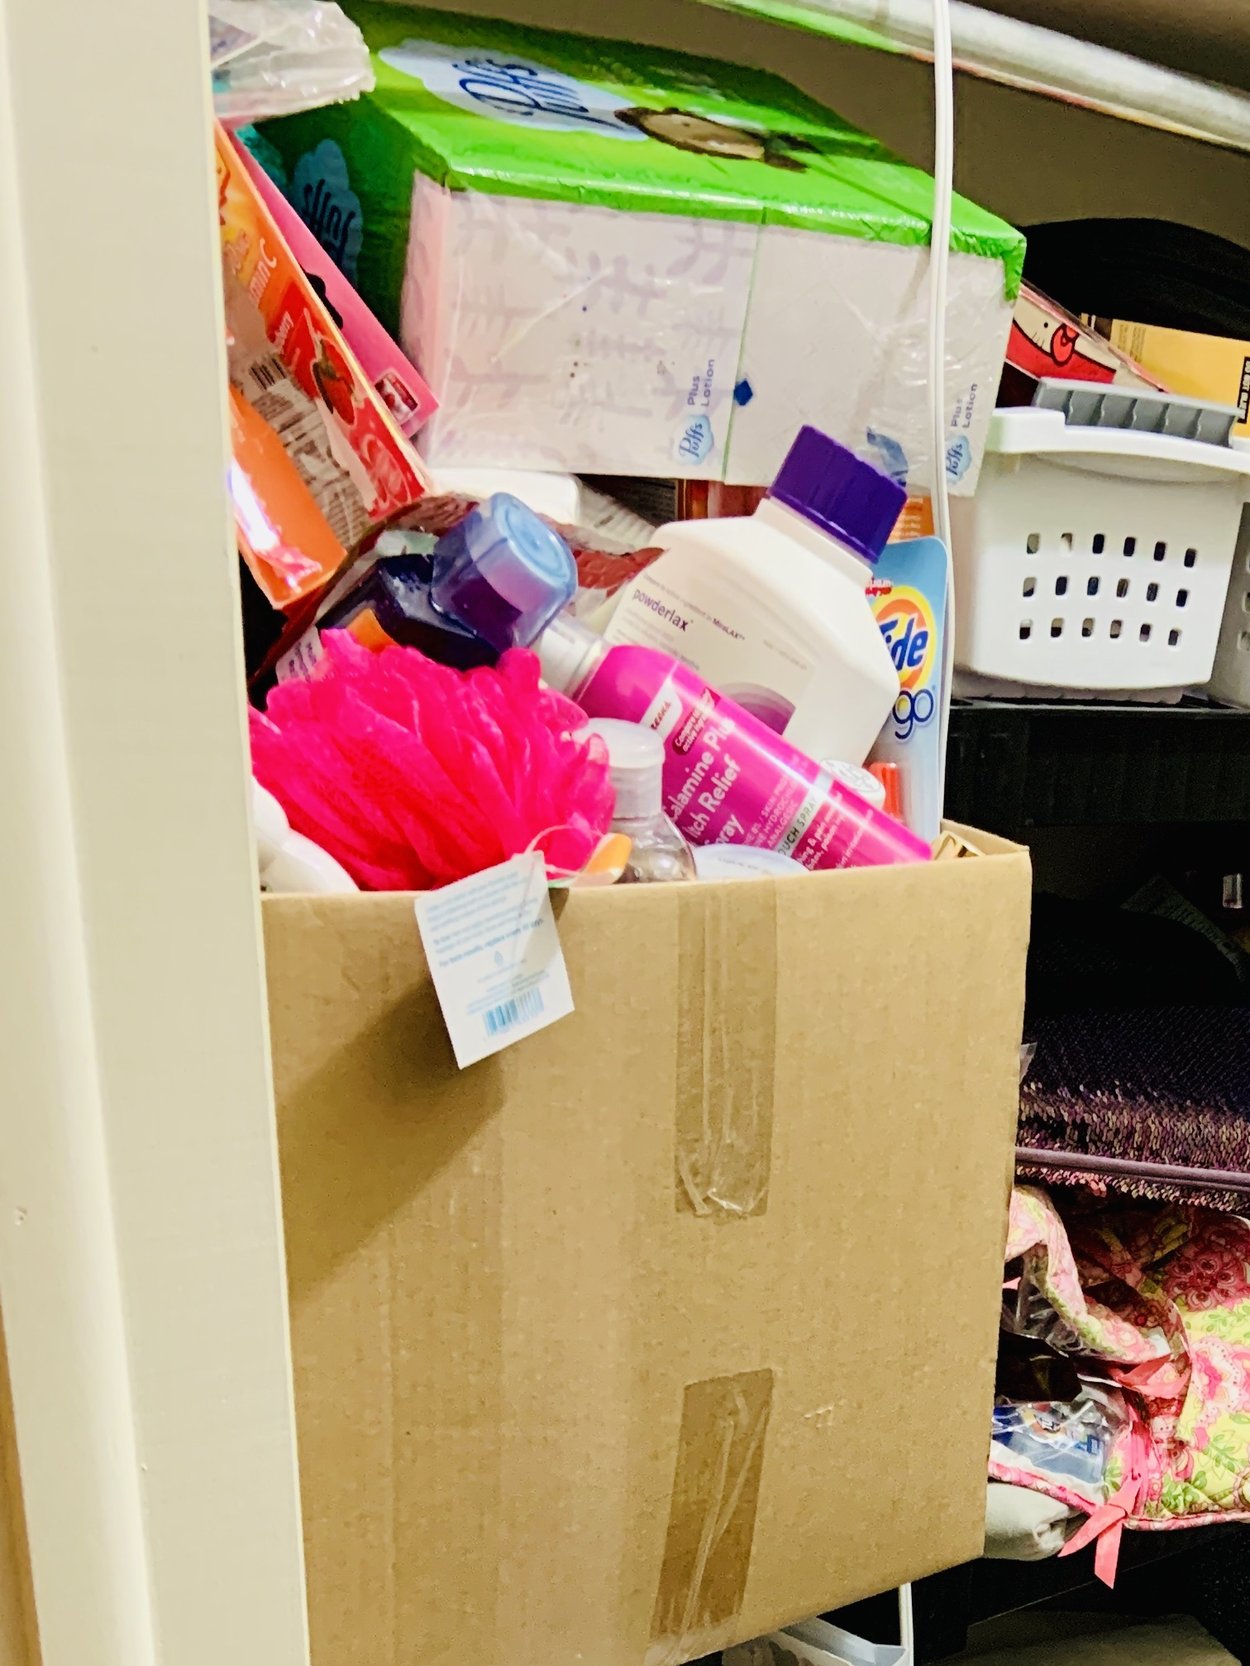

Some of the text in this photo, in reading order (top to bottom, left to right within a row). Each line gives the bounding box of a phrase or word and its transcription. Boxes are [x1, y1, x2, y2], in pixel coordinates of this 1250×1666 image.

[687, 374, 700, 405] Plus
[701, 359, 715, 407] Lotion
[965, 383, 978, 428] Lotion
[679, 420, 703, 459] Puffs
[632, 588, 690, 632] powderlax
[892, 688, 935, 740] go
[679, 752, 745, 839] Itch Relief
